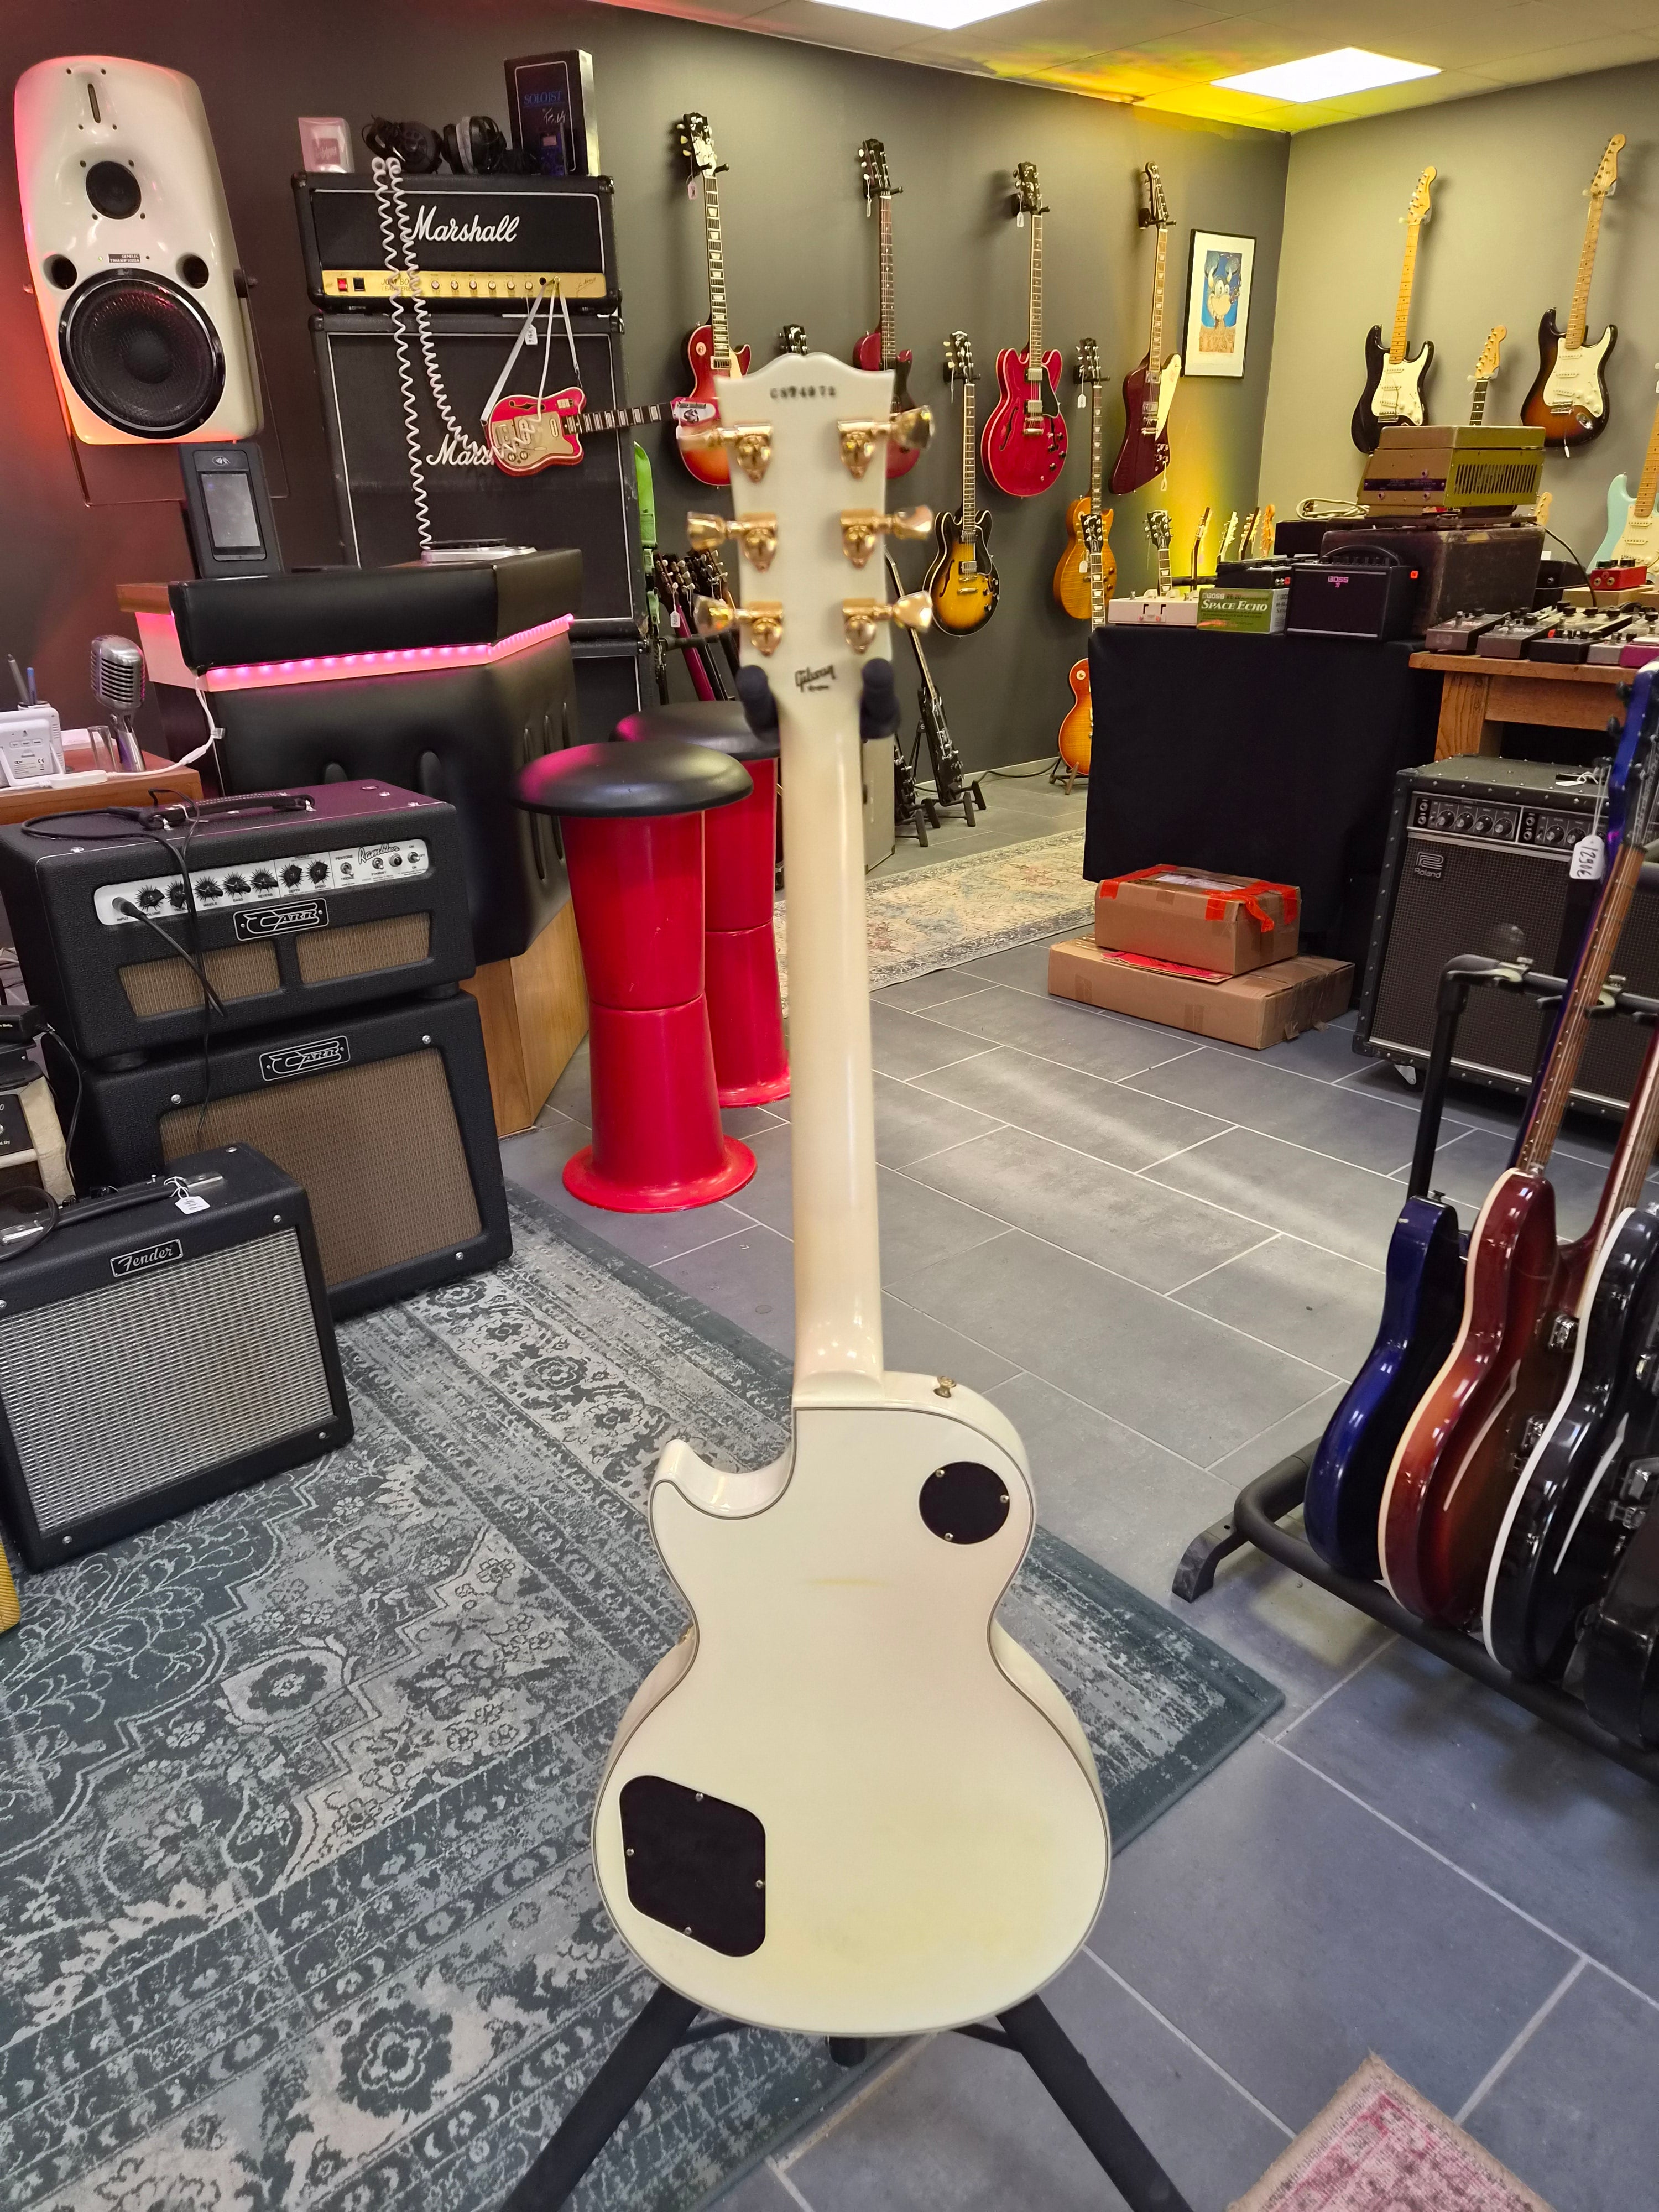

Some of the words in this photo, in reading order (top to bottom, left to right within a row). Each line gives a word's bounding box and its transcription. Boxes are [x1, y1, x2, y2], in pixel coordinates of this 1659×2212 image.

[524, 91, 562, 104] SOLOIST
[404, 205, 520, 242] Marshall
[1201, 599, 1236, 609] SPACE
[1236, 601, 1268, 611] ECHO
[358, 843, 400, 865] Rambler
[1414, 867, 1442, 878] Roland
[243, 902, 320, 935] CARR
[269, 1040, 342, 1074] CARR
[118, 1248, 174, 1272] Fender
